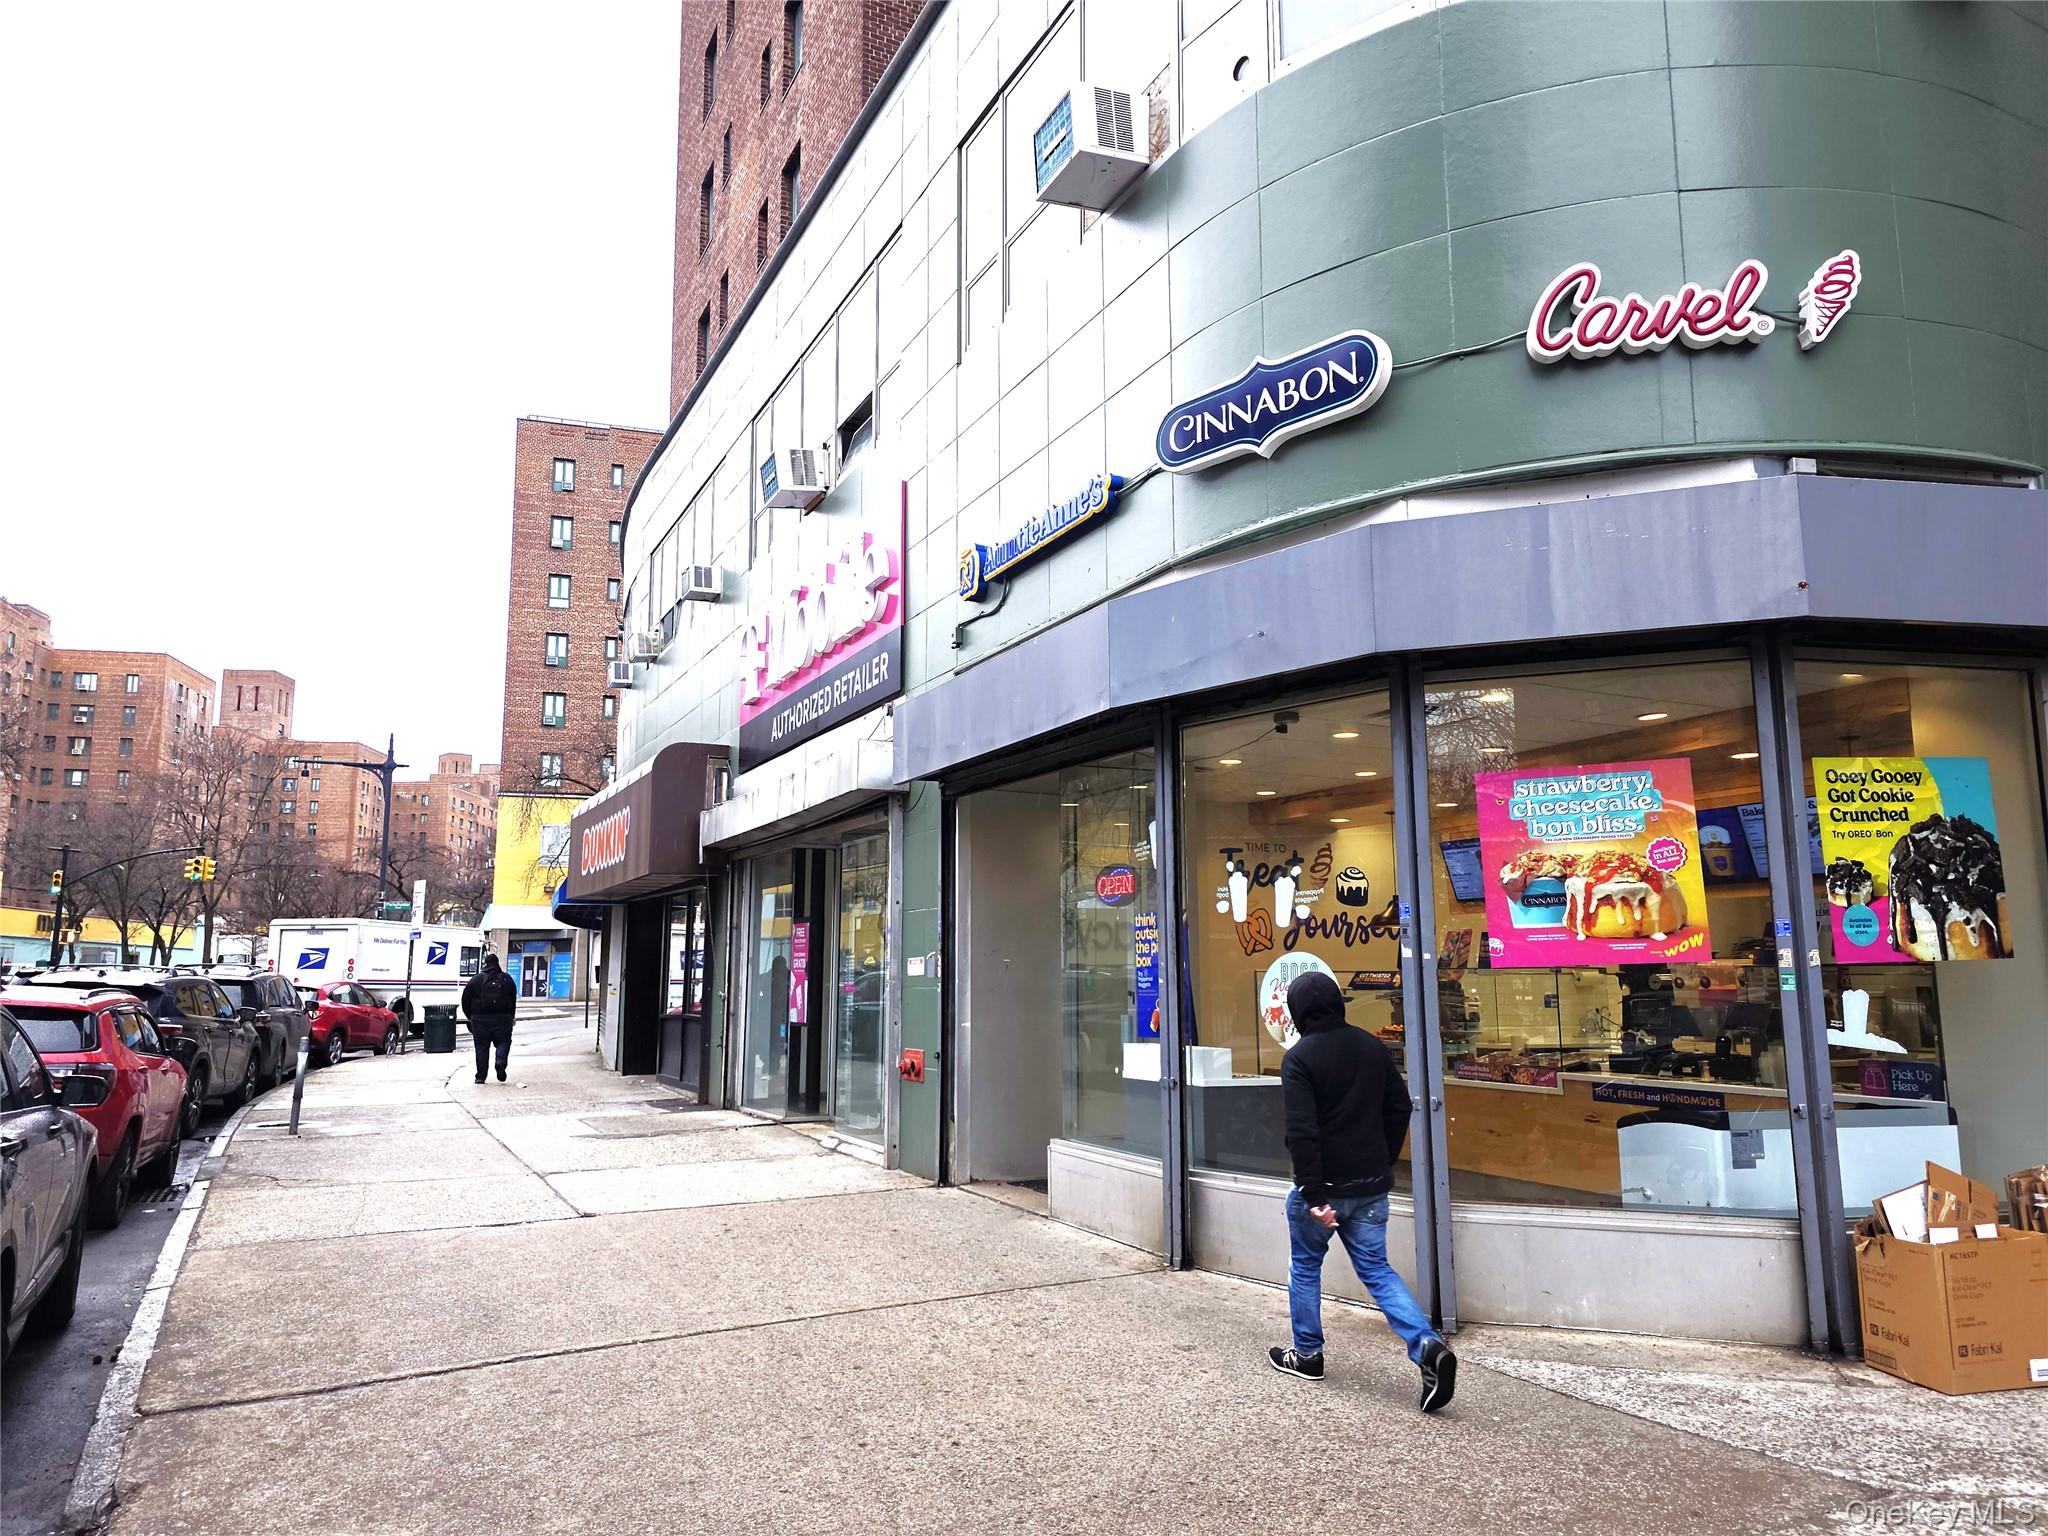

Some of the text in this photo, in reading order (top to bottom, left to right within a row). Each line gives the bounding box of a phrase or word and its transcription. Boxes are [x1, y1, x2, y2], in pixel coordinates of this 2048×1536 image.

[1535, 264, 1761, 352] Carvel
[1168, 351, 1358, 453] CINNABON
[770, 651, 889, 743] AUTHORIZED RETAILER
[1825, 768, 1922, 786] Ooey Gooey
[1515, 774, 1651, 798] strawberry.
[1827, 787, 1915, 803] Got Cookie
[1512, 792, 1659, 818] cheesecake.
[1829, 806, 1910, 822] Crunched
[1530, 813, 1645, 838] bon bliss.
[1832, 830, 1845, 839] Try
[1876, 830, 1893, 838] Bon
[1245, 842, 1287, 853] TIME TO
[1097, 874, 1135, 897] OPEN
[1135, 912, 1156, 928] think
[1135, 941, 1150, 953] the
[1136, 954, 1152, 967] box
[1891, 1069, 1932, 1083] Pick Up
[1892, 1081, 1919, 1092] Here
[1617, 1090, 1645, 1100] FRESH
[1646, 1094, 1660, 1102] and
